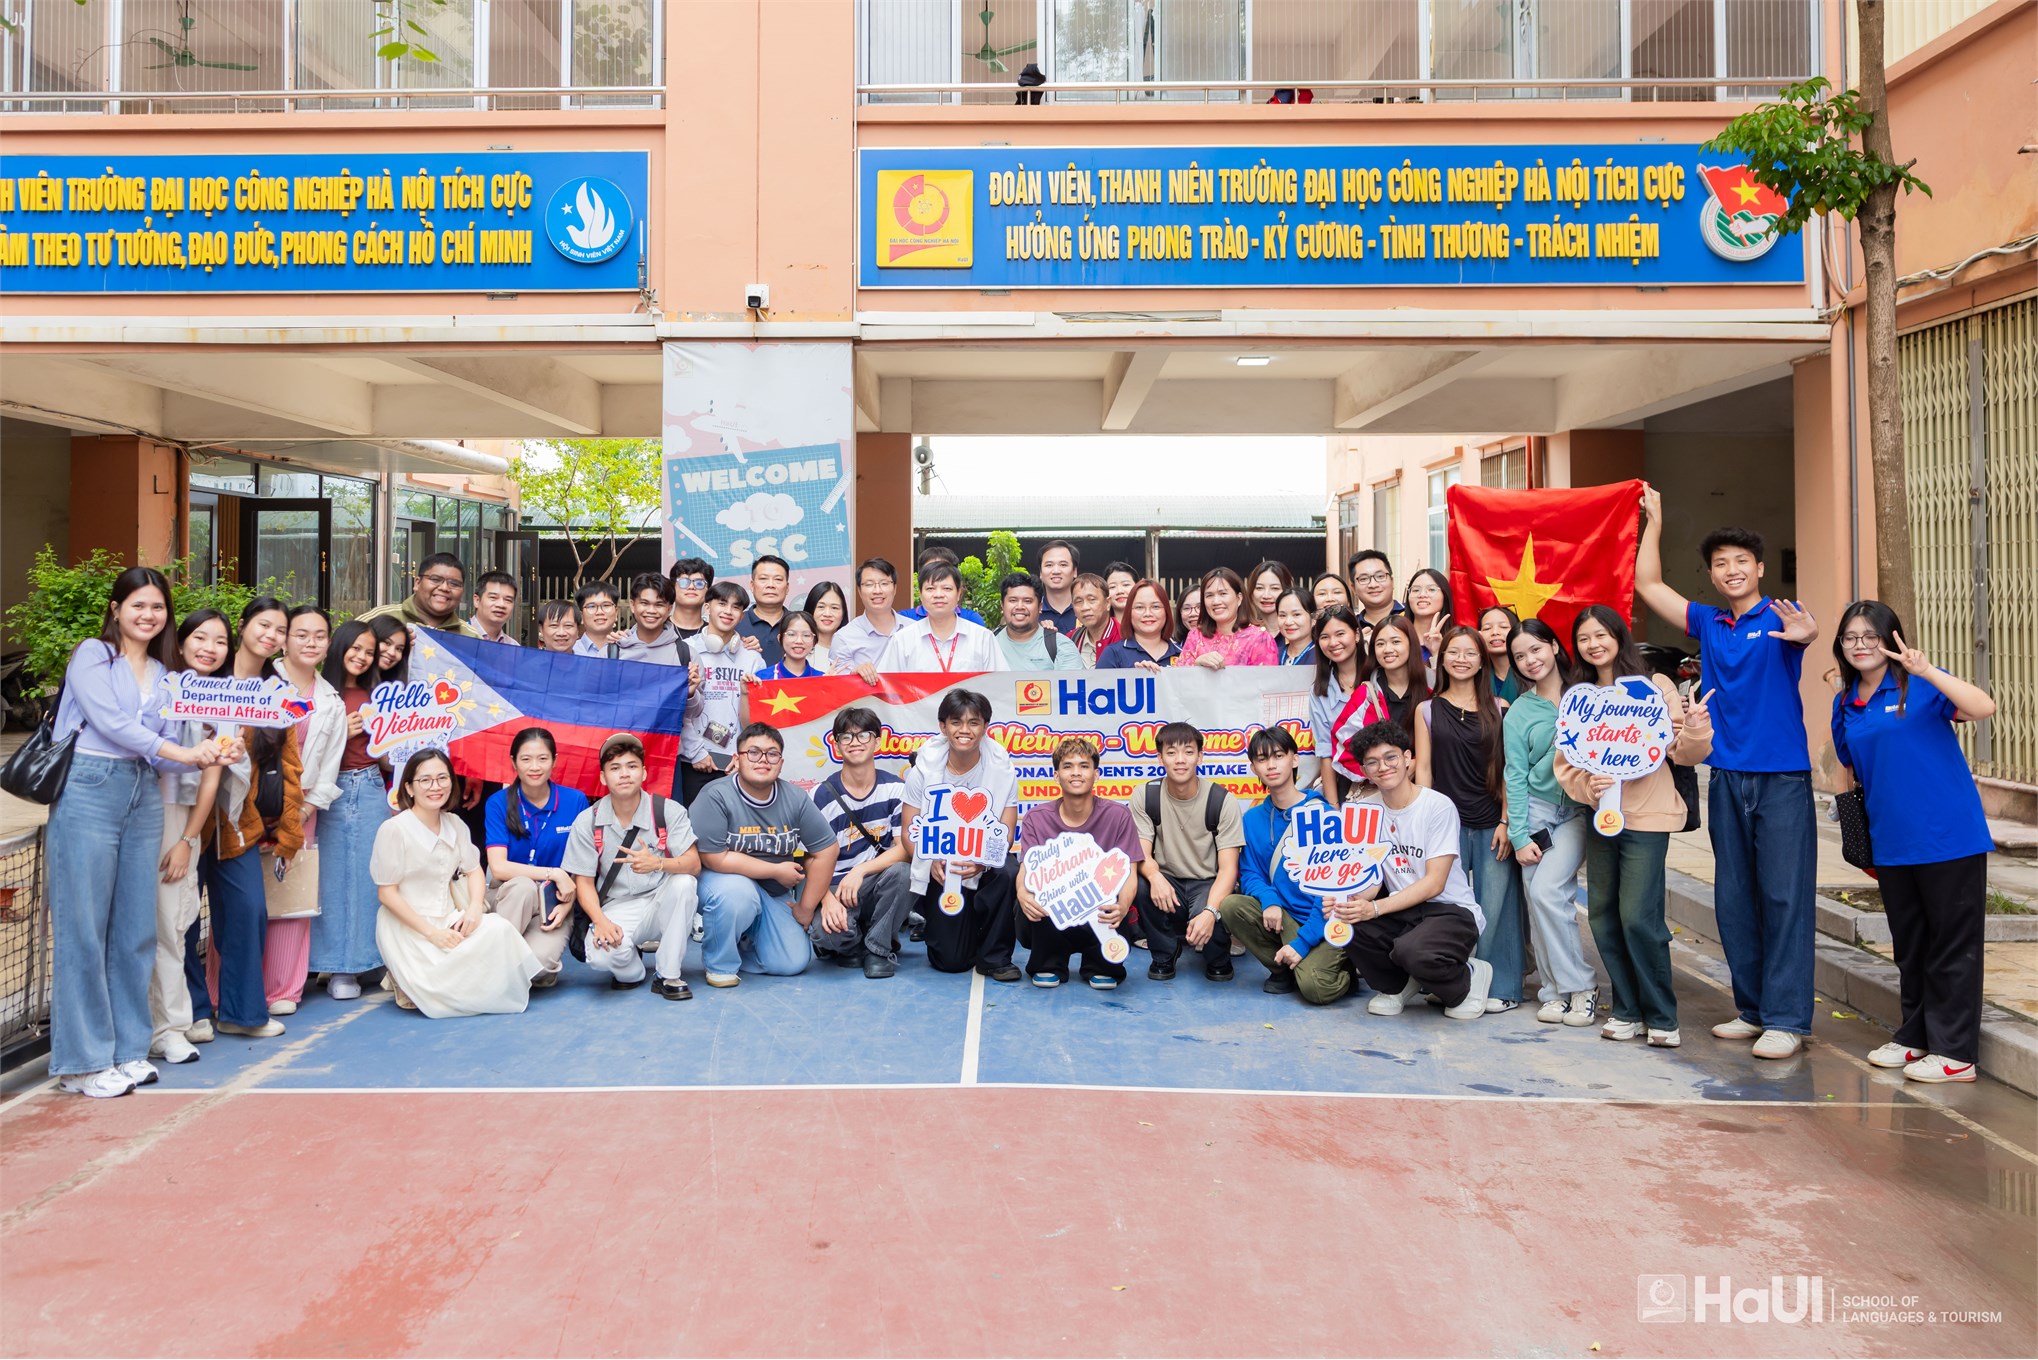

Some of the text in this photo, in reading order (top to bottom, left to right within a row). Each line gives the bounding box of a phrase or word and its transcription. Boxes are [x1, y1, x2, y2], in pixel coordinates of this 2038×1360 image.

[18, 170, 63, 211] VIÊN
[66, 166, 145, 211] TRƯỜNG
[151, 177, 184, 218] ĐẠI
[189, 177, 229, 218] HỌC
[234, 169, 288, 211] CÔNG
[294, 168, 364, 218] NGHIỆP
[366, 168, 394, 210] HÀ
[402, 168, 435, 217] NỘI
[441, 166, 485, 210] TÍCH
[491, 171, 532, 217] CỰC
[989, 157, 1685, 211] ĐOÀN VIÊN, THANH NIÊN TRƯỜNG ĐẠI HỌC CÔNG NGHIỆP HÀ NỘI TÍCH CỰC
[32, 232, 81, 266] THEO
[85, 229, 115, 266] TƯ
[115, 216, 187, 270] TƯỞNG,
[188, 231, 228, 272] ĐẠO
[234, 221, 279, 269] ĐỨC,
[281, 230, 347, 265] PHONG
[353, 222, 403, 265] CÁCH
[408, 217, 435, 265] HỒ
[441, 221, 476, 264] CHÍ
[480, 230, 532, 264] MINH
[569, 248, 585, 258] SINH
[613, 229, 625, 245] NAM
[1006, 210, 1072, 260] HƯỞNG
[1078, 213, 1120, 260] ỨNG
[1127, 224, 1192, 260] PHONG
[1264, 211, 1289, 260] KỶ
[1295, 221, 1363, 260] CƯƠNG
[1380, 215, 1425, 260] TÌNH
[1431, 220, 1509, 260] THƯƠNG
[1526, 214, 1590, 259] TRÁCH
[1595, 213, 1659, 266] NHIỆM
[681, 458, 837, 493] WELCOME
[730, 534, 808, 567] SSC
[180, 672, 262, 692] Connect with
[182, 689, 272, 705] Department of
[375, 683, 433, 713] Hello
[1058, 677, 1156, 715] HaUI
[174, 701, 279, 720] External Affairs
[1567, 694, 1665, 727] My journey
[370, 711, 454, 746] Vietnam
[1586, 722, 1643, 744] starts
[1196, 764, 1247, 776] NTAKE
[1600, 747, 1642, 767] here
[928, 788, 951, 823] I
[922, 825, 984, 858] HaUI
[1296, 807, 1380, 847] HaUI
[1028, 835, 1074, 871] Study in
[1029, 846, 1099, 891] Vietnam,
[1307, 847, 1350, 866] here
[1038, 871, 1089, 908] Shine with
[1304, 862, 1363, 885] we go
[1050, 882, 1103, 925] HaUI
